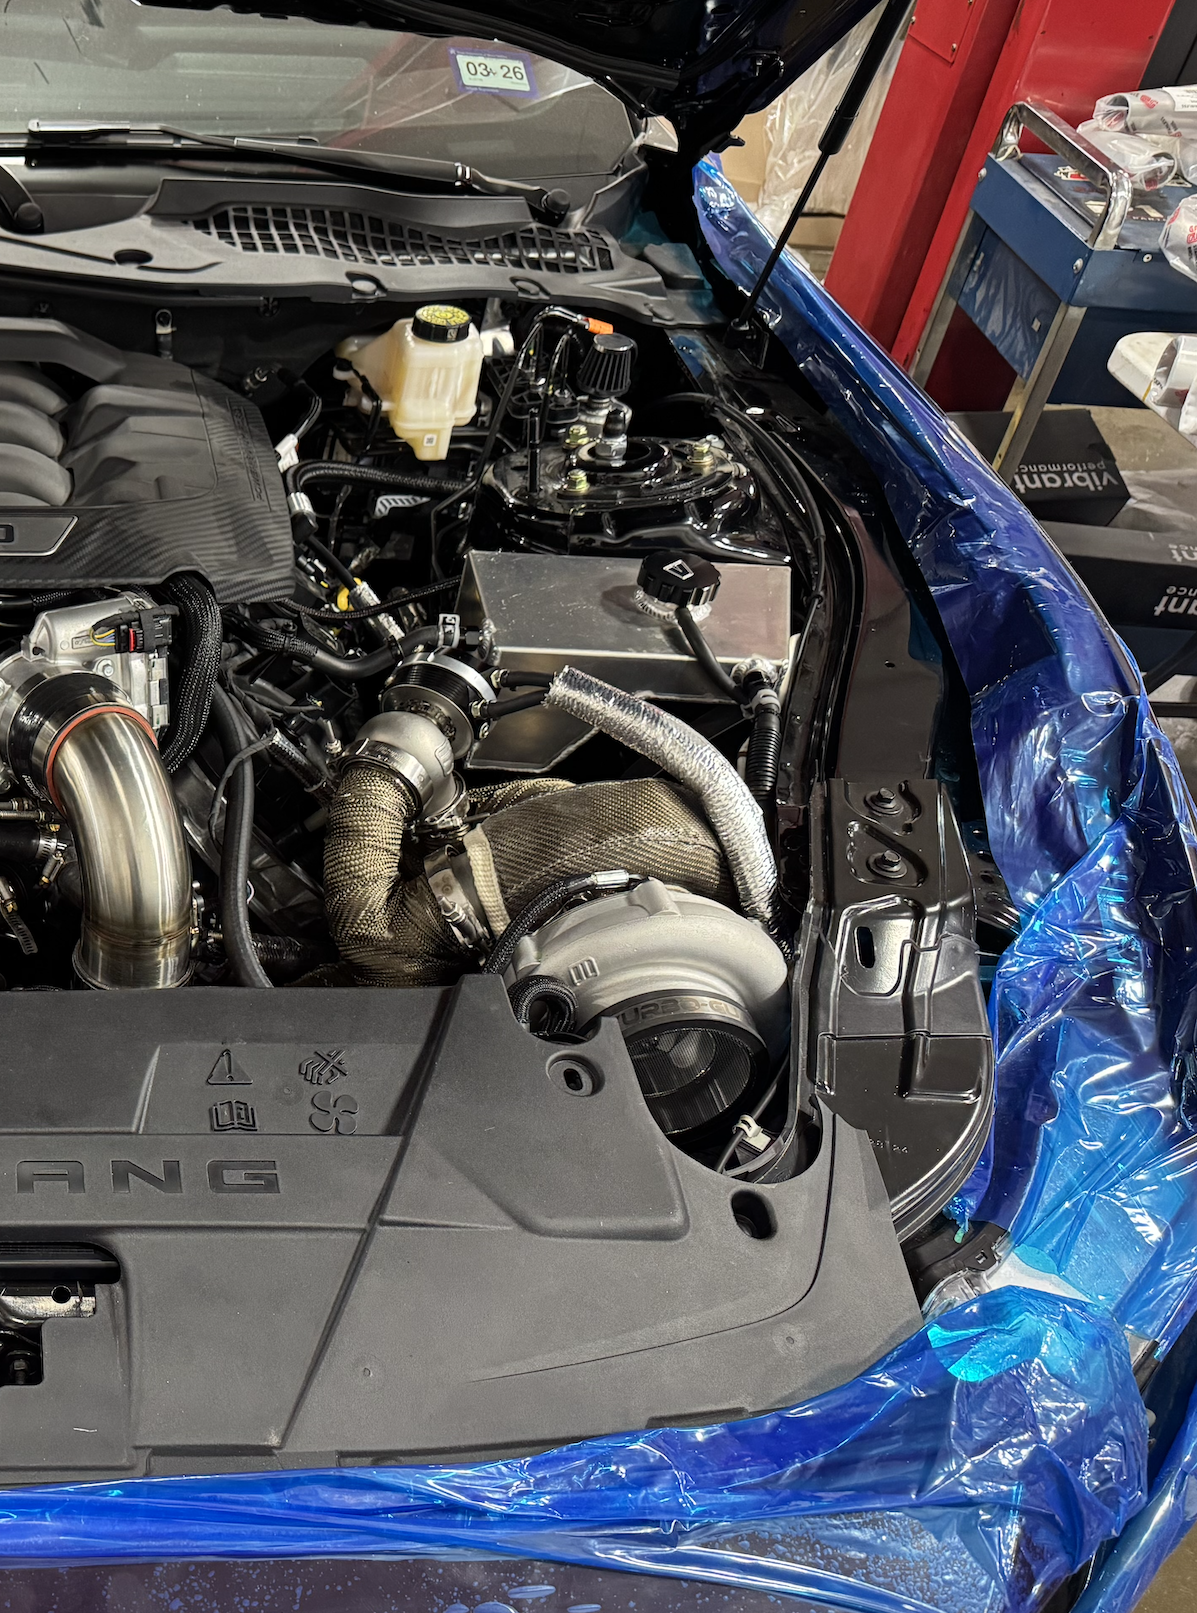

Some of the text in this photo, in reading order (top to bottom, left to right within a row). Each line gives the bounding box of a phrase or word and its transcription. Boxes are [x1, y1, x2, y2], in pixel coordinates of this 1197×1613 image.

[500, 64, 525, 81] 26
[1015, 459, 1107, 474] performanc
[1013, 471, 1119, 494] vibrant
